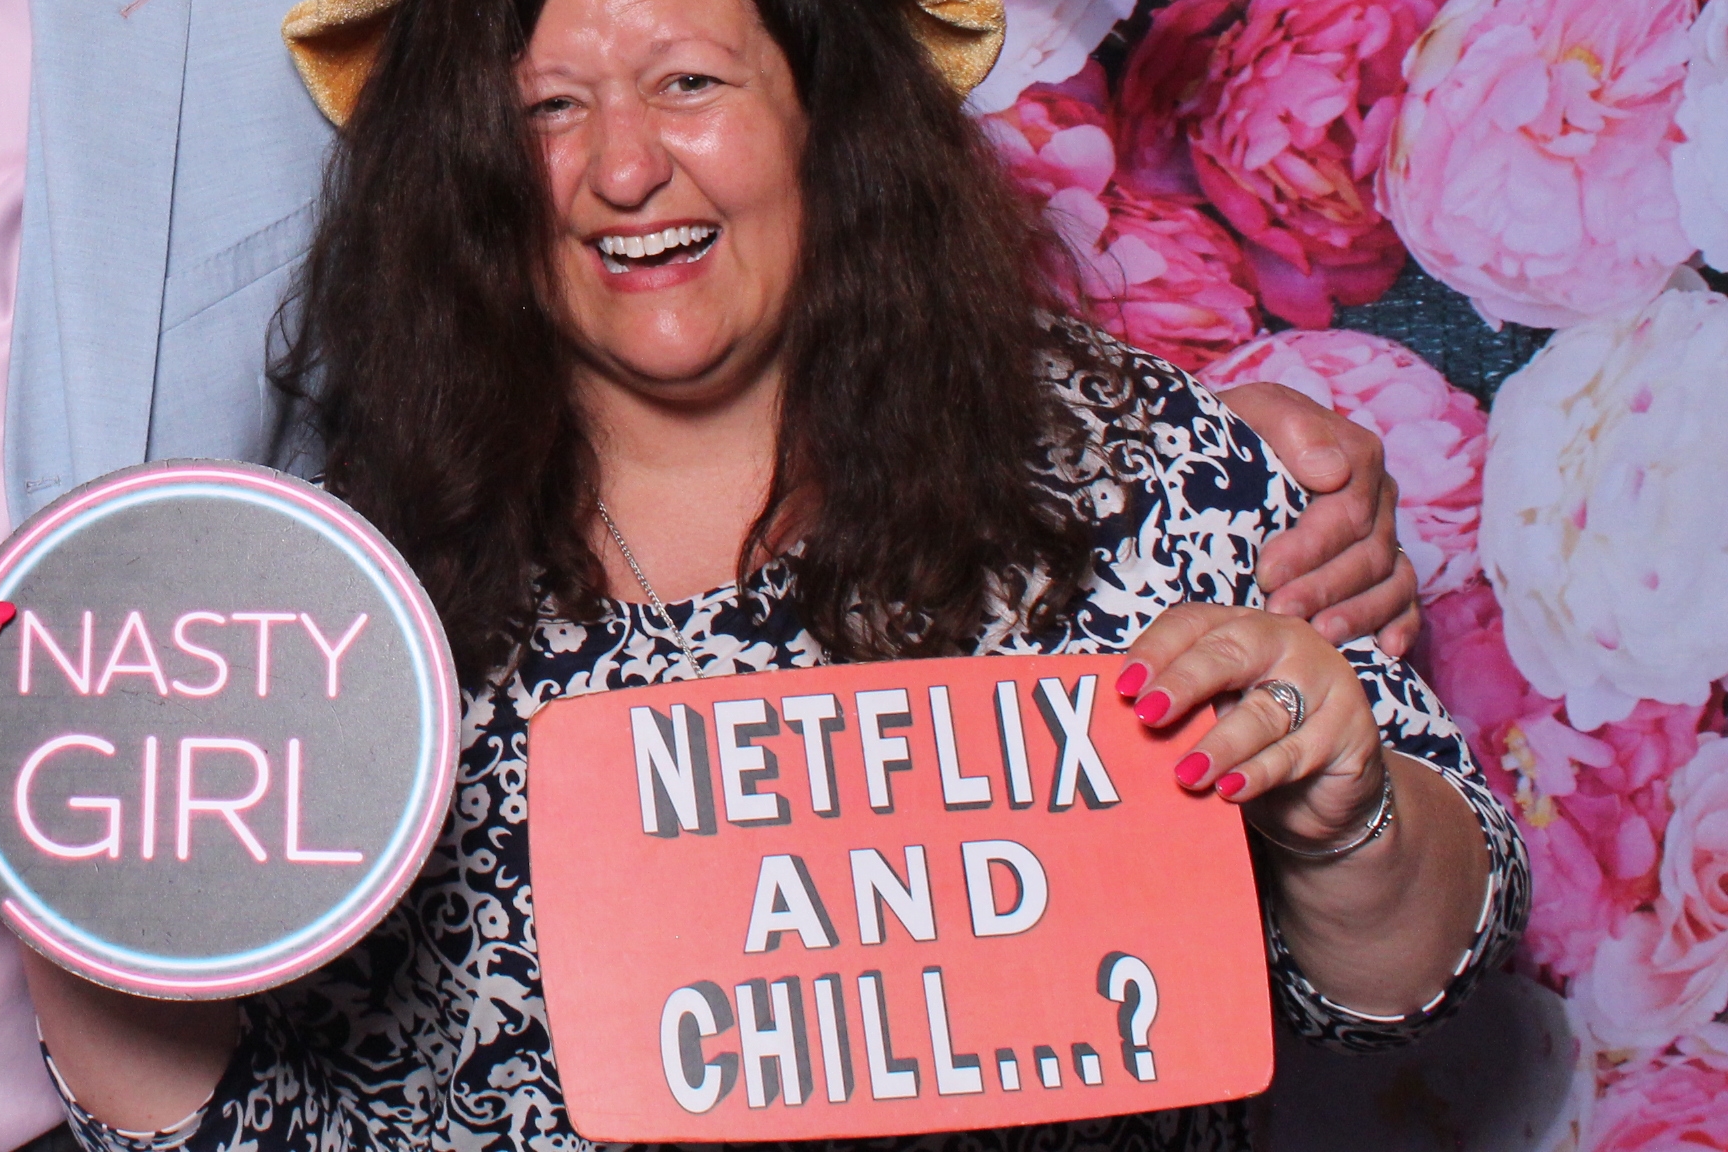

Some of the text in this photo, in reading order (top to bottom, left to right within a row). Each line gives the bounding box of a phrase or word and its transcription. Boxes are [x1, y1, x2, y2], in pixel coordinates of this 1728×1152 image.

[18, 609, 368, 698] NASTY
[15, 733, 364, 863] GIRL
[629, 674, 1121, 838] NETFLIX
[743, 839, 1049, 954] AND
